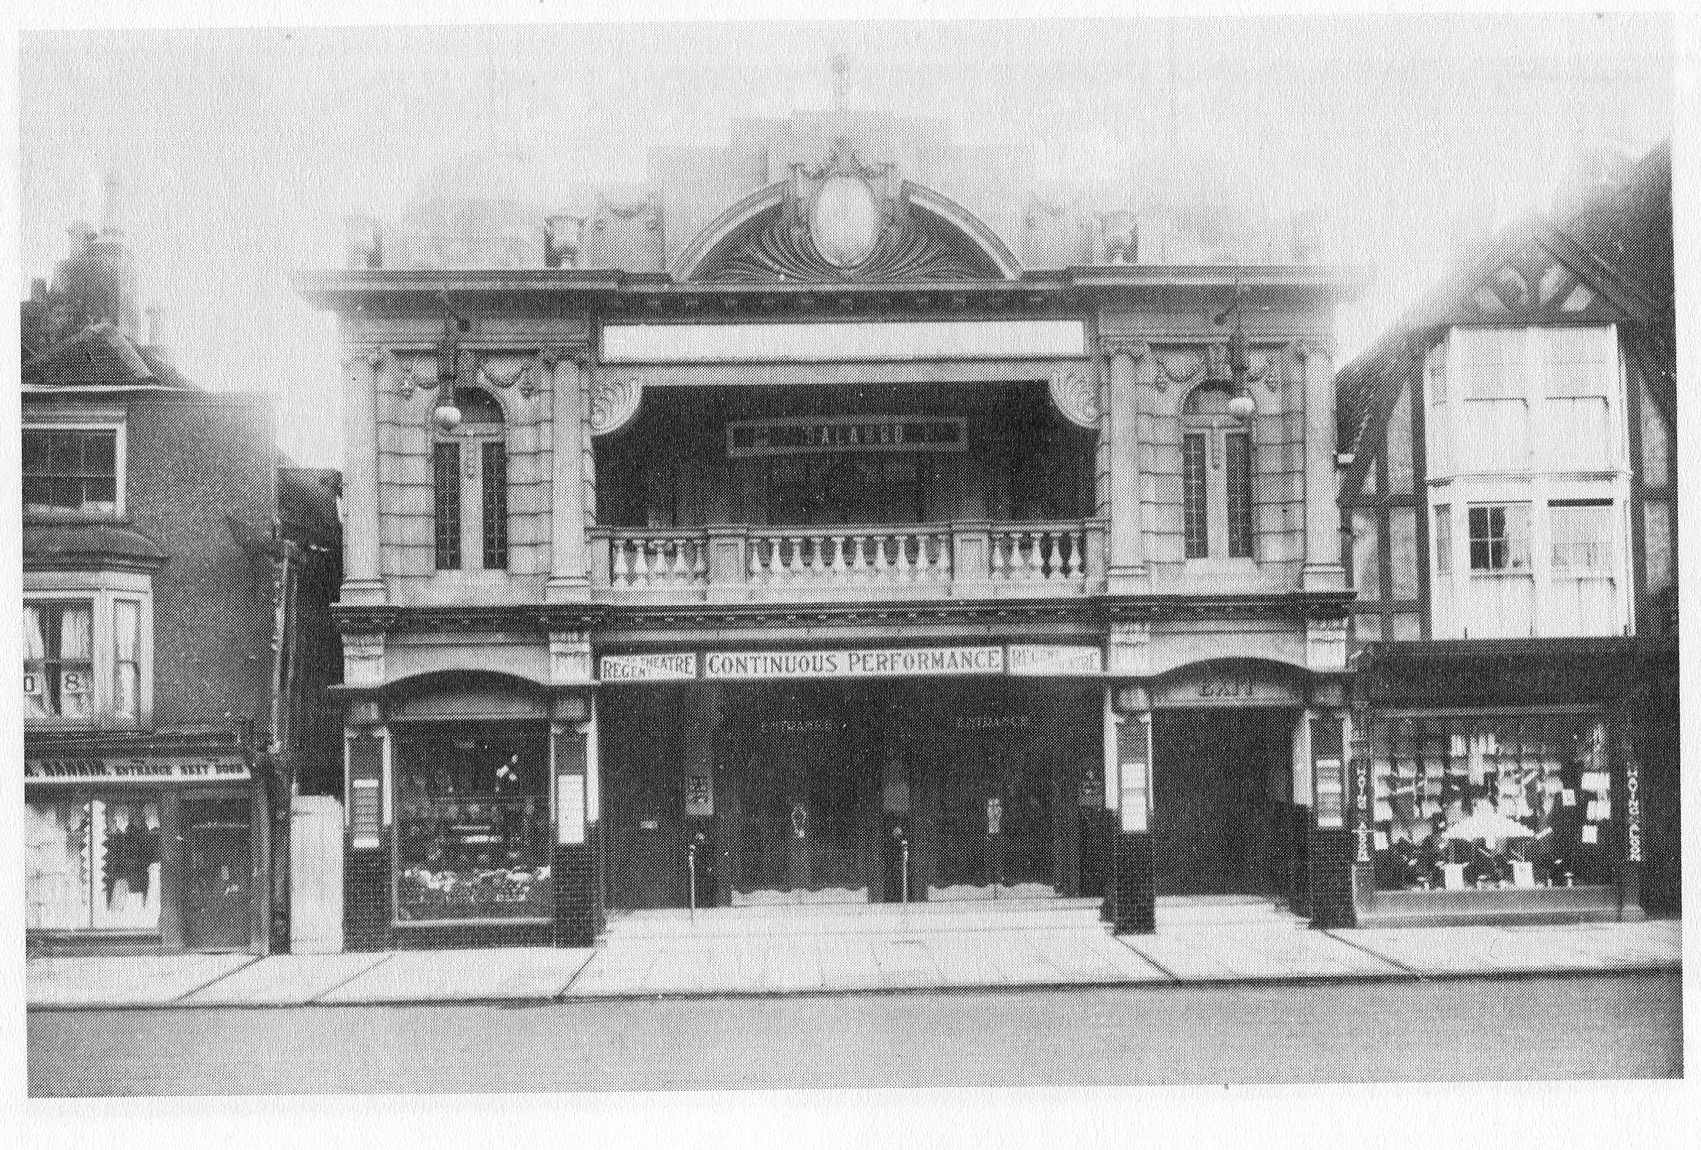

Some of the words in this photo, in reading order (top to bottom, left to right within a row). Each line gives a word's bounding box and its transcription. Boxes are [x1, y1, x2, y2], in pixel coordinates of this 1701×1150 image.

[708, 653, 838, 675] CONTINUOUS
[848, 649, 1001, 672] PERFORMANCE
[114, 764, 173, 776] ENTRANCE
[180, 763, 209, 775] NEXT
